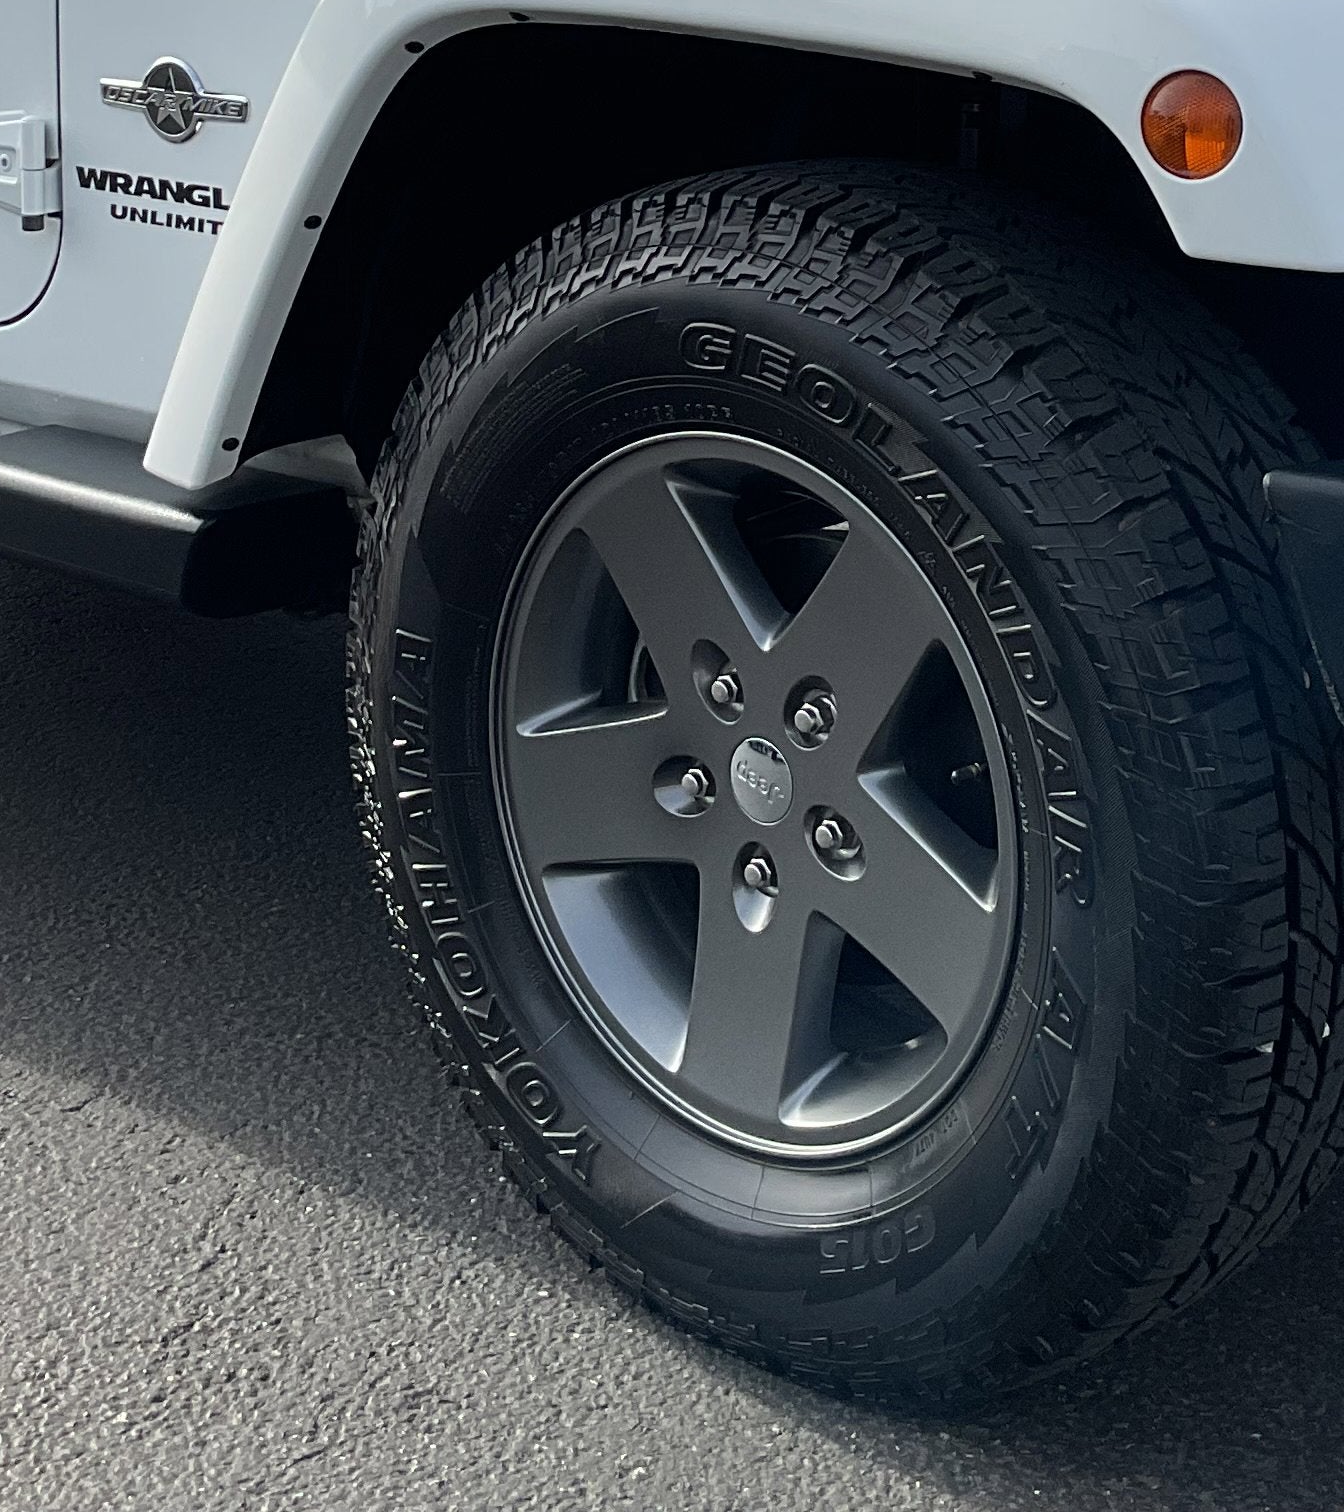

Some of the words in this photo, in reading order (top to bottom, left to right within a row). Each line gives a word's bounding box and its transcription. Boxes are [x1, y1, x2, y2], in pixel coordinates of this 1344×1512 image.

[104, 84, 179, 112] OSCAR
[181, 96, 244, 117] MIKE
[76, 165, 231, 211] WRANGL
[109, 203, 224, 235] UNLIMIT
[678, 320, 1093, 909] GEOLANDAR
[736, 759, 785, 806] Jeep
[393, 627, 602, 1183] YOKOHAMA
[818, 1203, 938, 1276] G015
